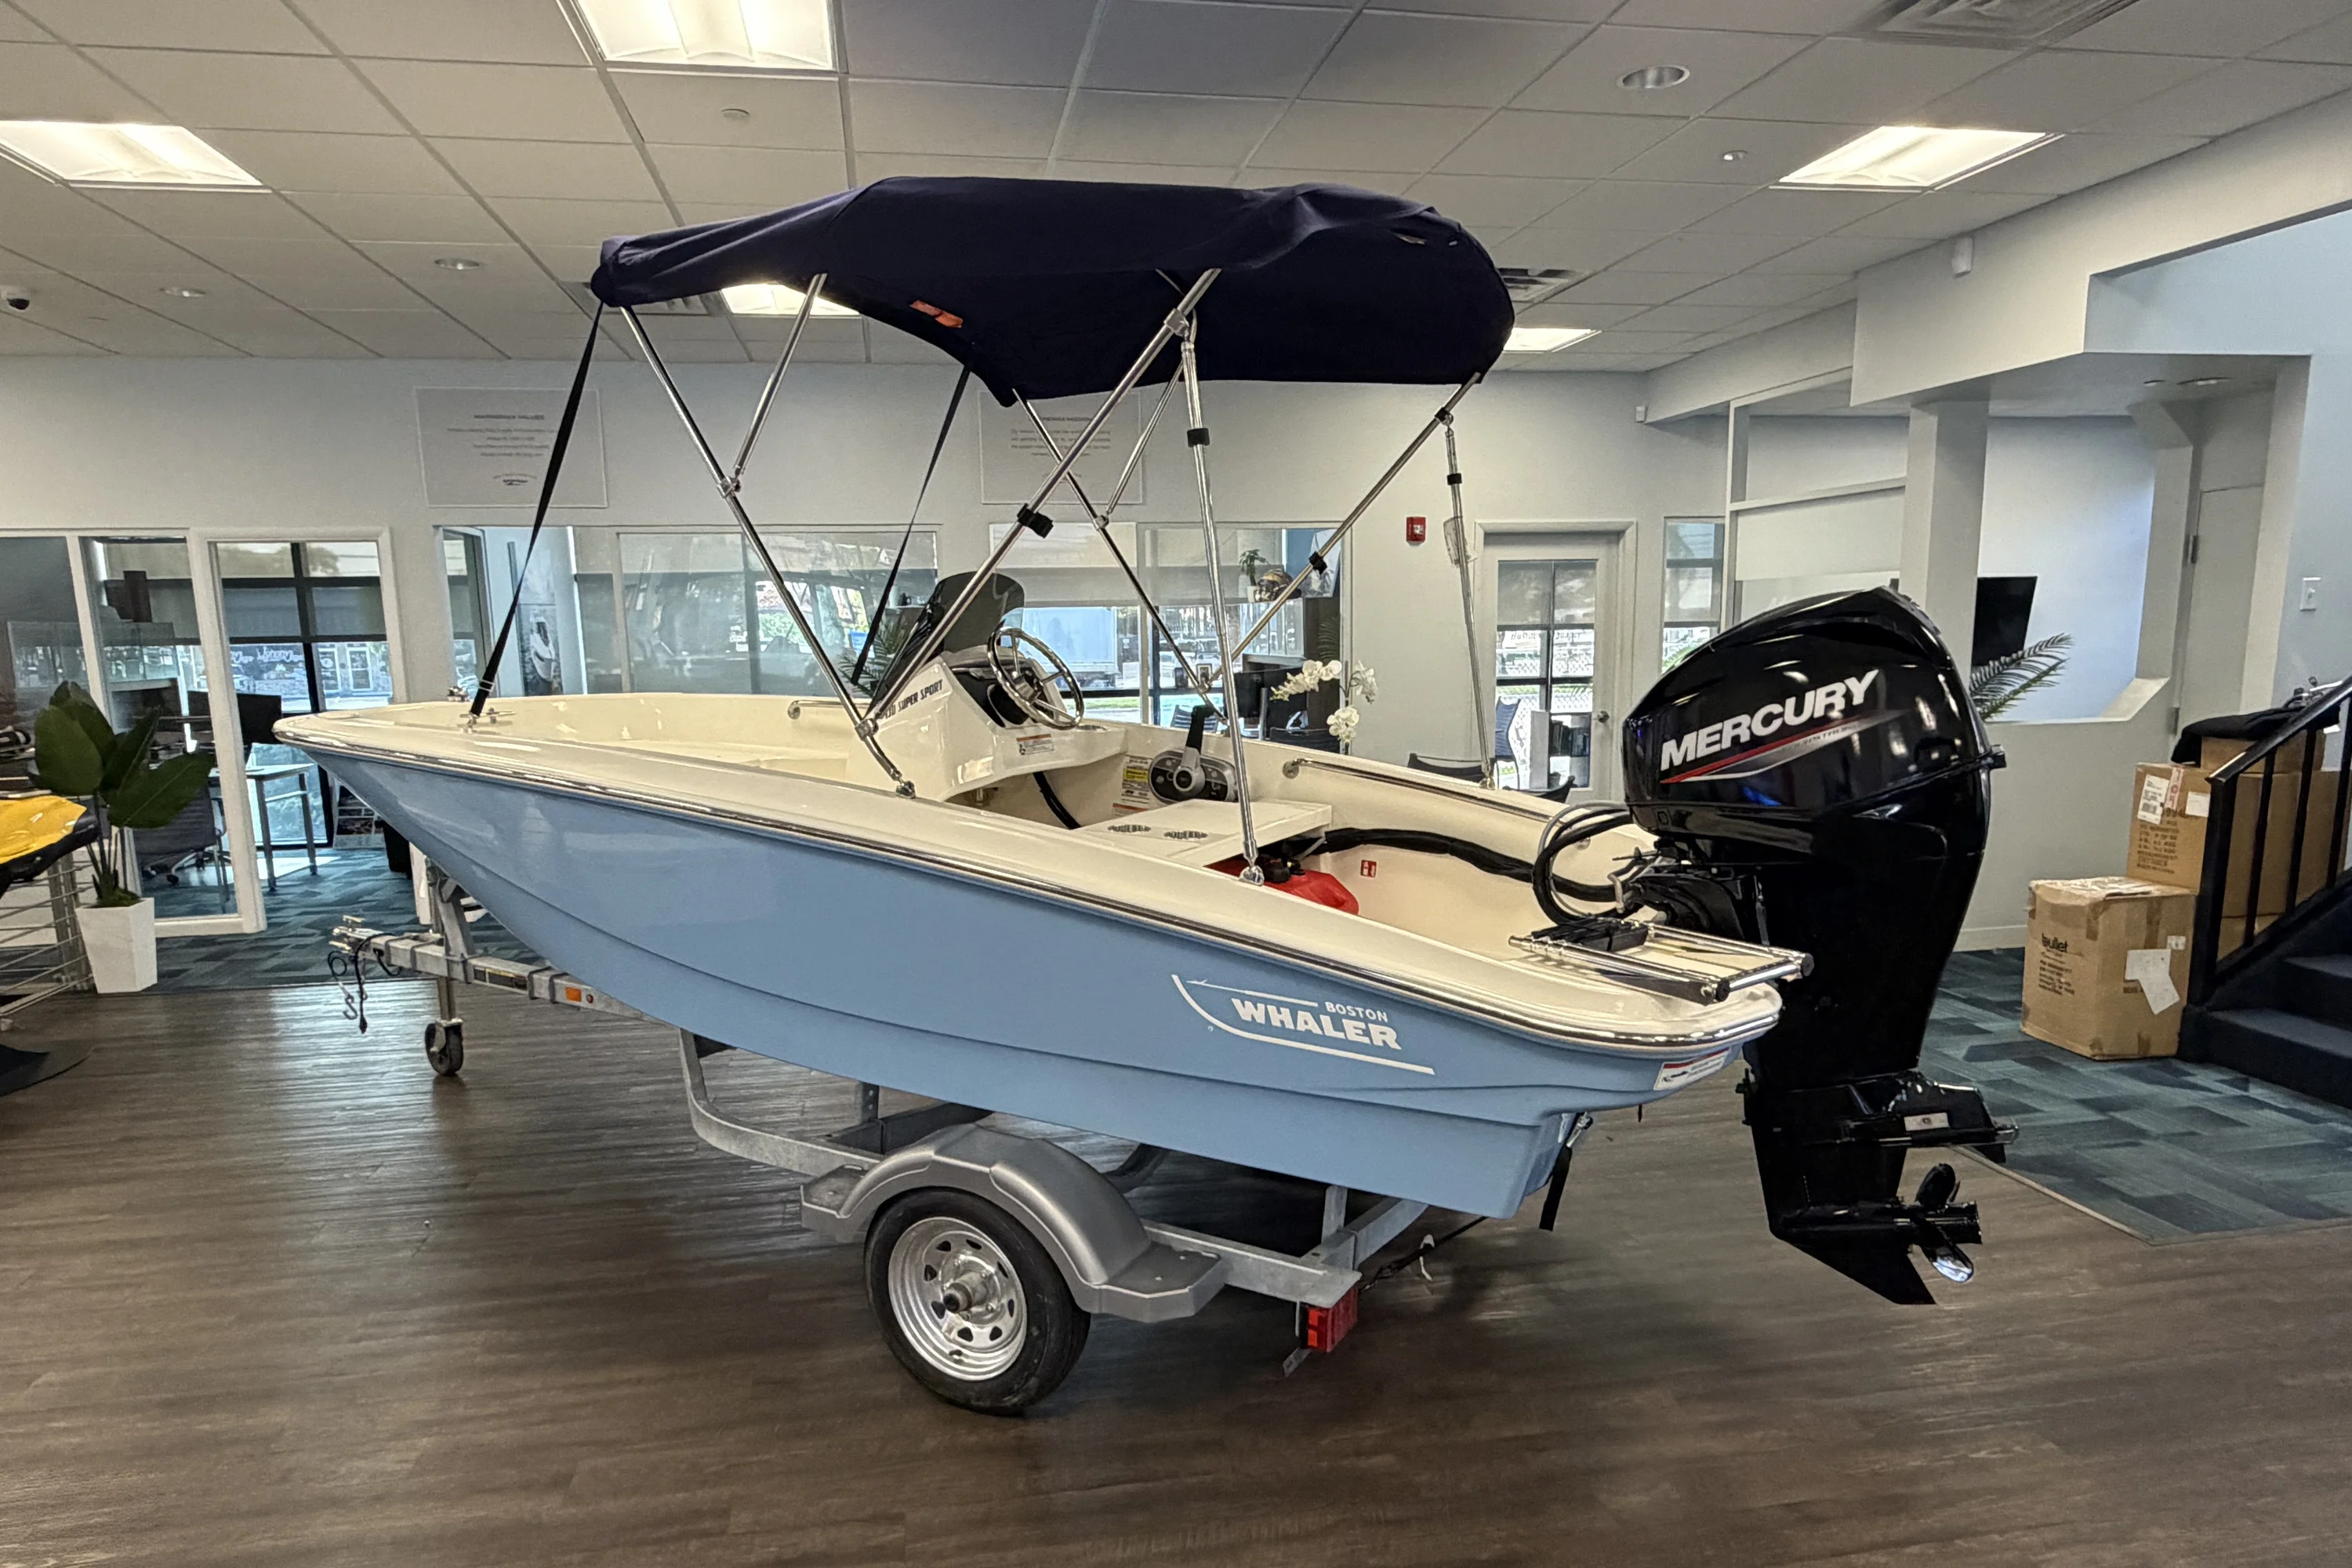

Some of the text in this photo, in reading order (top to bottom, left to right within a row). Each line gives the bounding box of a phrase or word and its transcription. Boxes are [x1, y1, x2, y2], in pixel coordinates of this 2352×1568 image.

[898, 691, 918, 712] SUPER
[920, 679, 942, 700] SPORT
[1660, 669, 1880, 771] MERCURY
[1231, 998, 1402, 1051] WHALER
[1325, 1001, 1388, 1023] BOSTON
